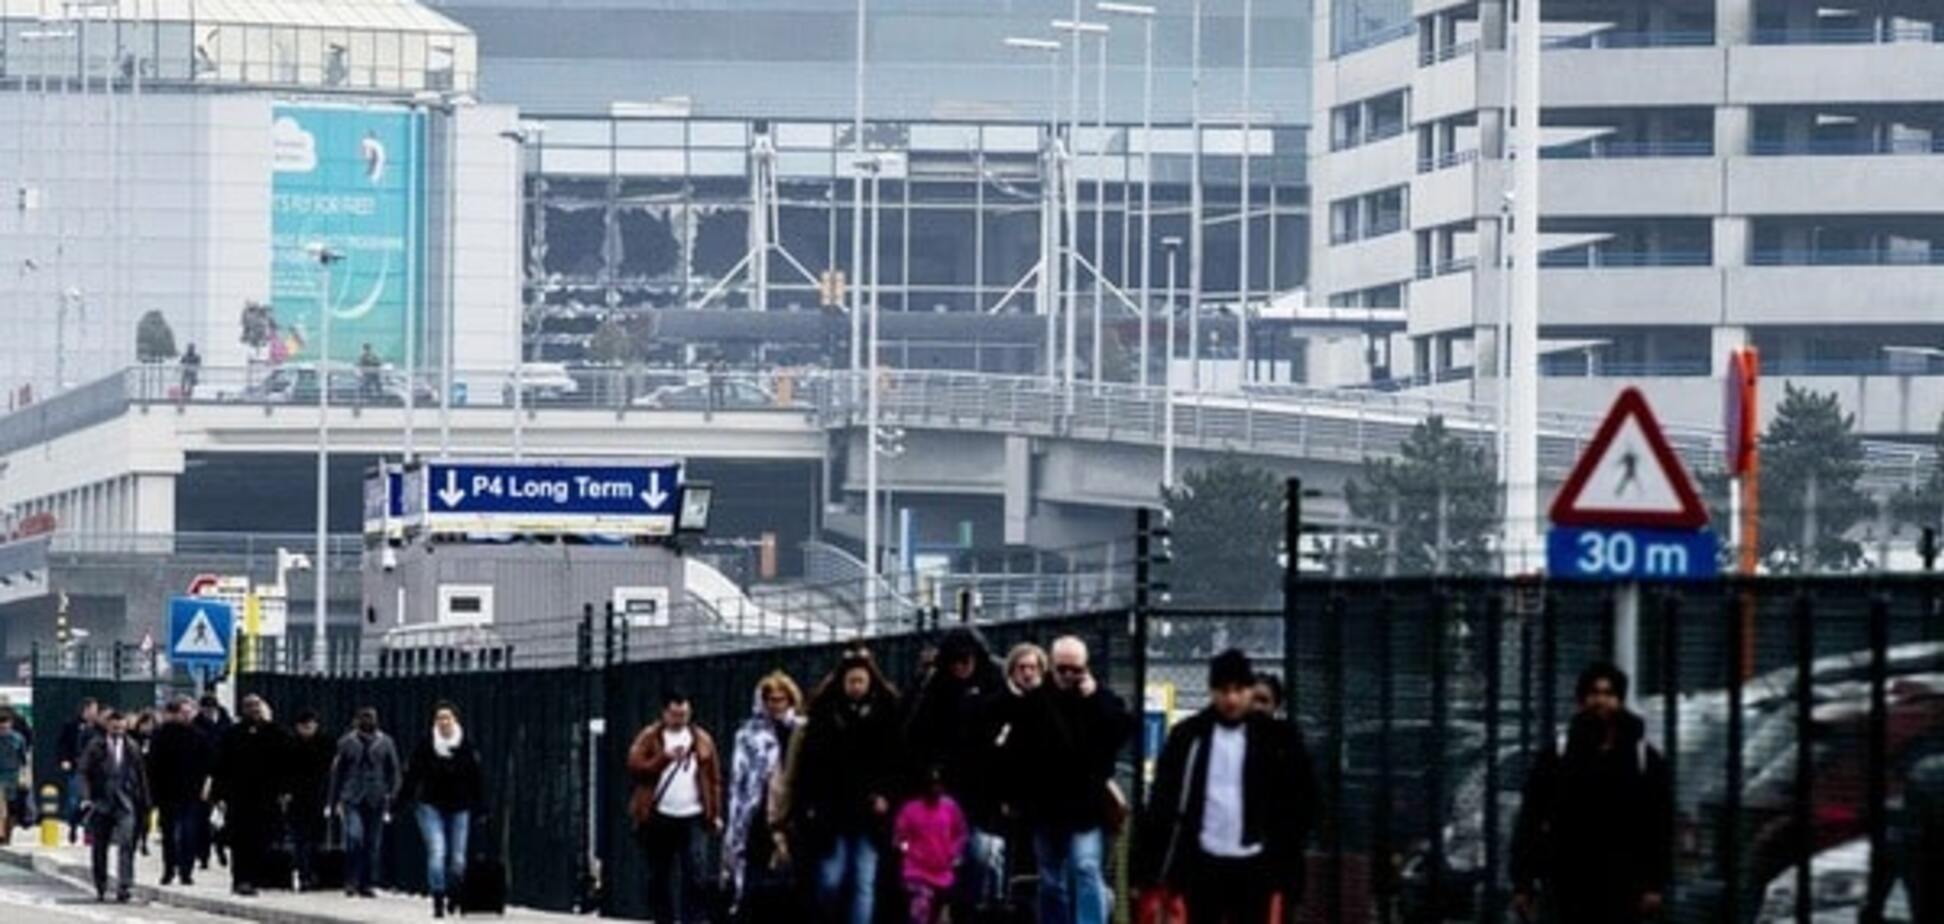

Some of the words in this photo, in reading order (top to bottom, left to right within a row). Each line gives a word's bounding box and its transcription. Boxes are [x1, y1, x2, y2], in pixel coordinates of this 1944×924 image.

[472, 475, 504, 498] P4
[508, 475, 570, 504] Long
[573, 475, 634, 499] Term
[1576, 531, 1636, 573] 30
[1645, 542, 1688, 575] m
